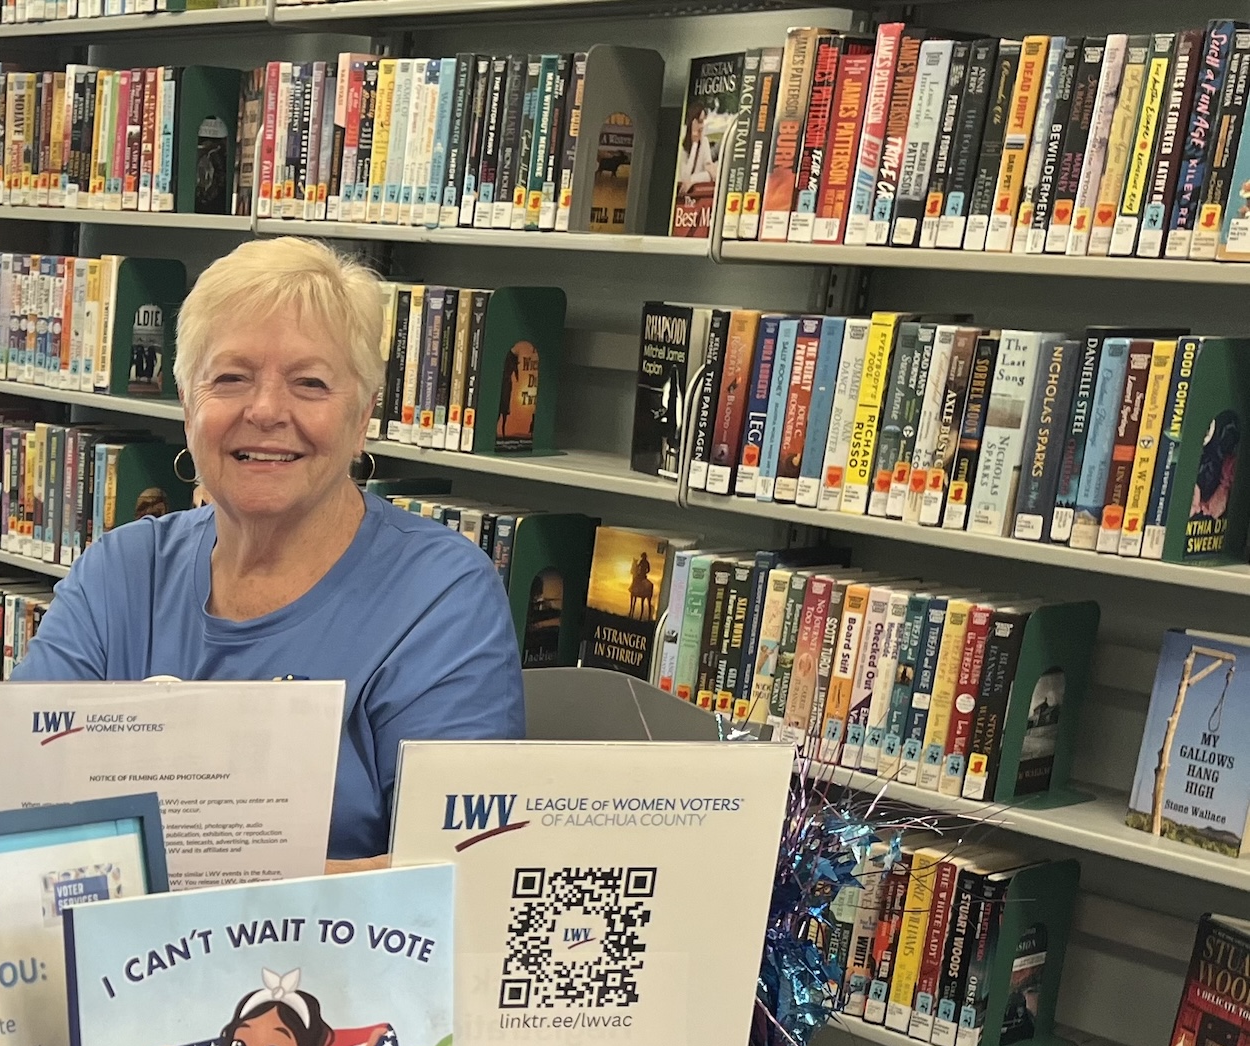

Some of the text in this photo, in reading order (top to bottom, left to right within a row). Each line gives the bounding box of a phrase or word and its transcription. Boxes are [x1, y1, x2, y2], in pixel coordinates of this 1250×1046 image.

[897, 36, 920, 73] JAMES
[695, 75, 736, 95] HIGGINS
[868, 34, 896, 124] JAMES PATTERSON
[1023, 62, 1035, 94] DEAD
[540, 95, 551, 133] WITHOUT
[839, 78, 862, 117] JAMES
[734, 75, 756, 162] BACK TRAIL
[1161, 109, 1178, 154] FOREVER
[775, 121, 799, 167] BURN
[1032, 124, 1062, 229] BEWILDERMENT
[1183, 158, 1198, 200] KILEY
[645, 313, 686, 345] RHAPSODY
[1005, 338, 1027, 352] The
[642, 360, 663, 376] Kaplan
[666, 349, 685, 363] James
[1002, 357, 1025, 367] Last
[1180, 342, 1195, 378] GOOD
[973, 359, 990, 399] SORREL
[997, 369, 1024, 385] Song
[1072, 338, 1098, 434] DANIELLE STEEL
[699, 371, 713, 429] THE PARIS
[1032, 346, 1063, 478] NICHOLAS SPARKS
[849, 422, 864, 468] RUSSO
[859, 415, 875, 477] RICHARD
[594, 625, 647, 650] A STRANGER
[594, 642, 643, 667] IN STIRRUP
[840, 617, 856, 674] Board Stiff
[870, 623, 884, 667] Checked
[32, 711, 76, 732] LWV
[86, 714, 124, 724] LEAGUE
[86, 723, 164, 732] WOMEN VOTERS
[1178, 743, 1234, 769] GALLOWS
[1201, 731, 1219, 749] MY
[1184, 780, 1214, 800] HIGH
[1186, 763, 1220, 784] HANG
[442, 794, 517, 830] LWV
[526, 798, 740, 811] LEAGUE WOMEN VOTERS
[564, 813, 707, 827] ALACHUA COUNTY
[1191, 805, 1226, 825] Wallace
[948, 893, 970, 979] STUART WOODS
[102, 918, 435, 999] I CAN'T WAIT TO VOTE
[499, 1012, 632, 1030] linktr.ee/lwvac
